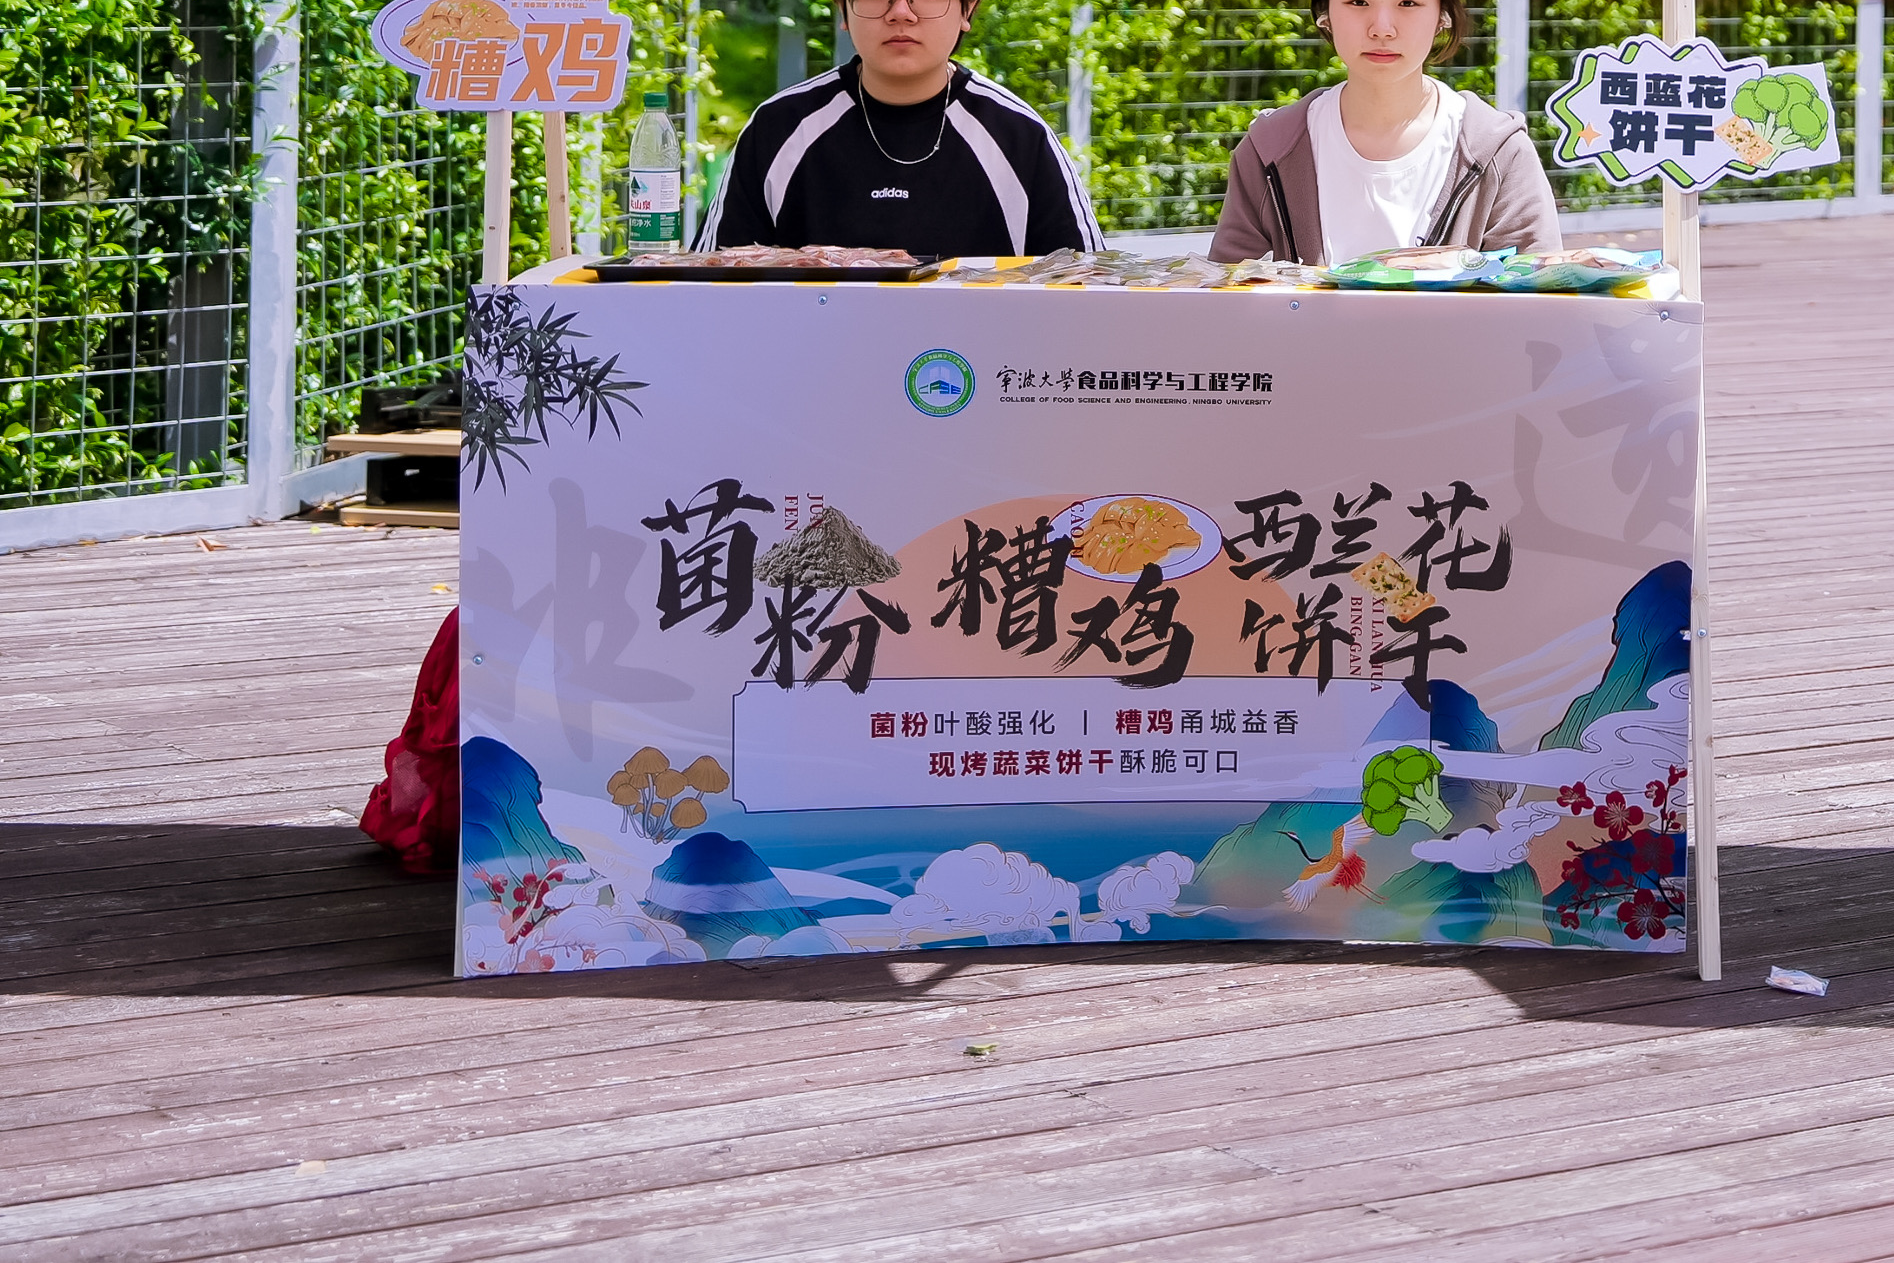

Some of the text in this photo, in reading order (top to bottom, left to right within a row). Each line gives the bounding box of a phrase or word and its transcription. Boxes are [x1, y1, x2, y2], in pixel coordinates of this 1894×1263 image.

[425, 18, 621, 102] 糟鸡
[1600, 71, 1727, 109] 西蓝花
[1609, 109, 1715, 156] 饼干
[871, 187, 909, 198] adidas
[1226, 398, 1273, 406] UNIVERSITY
[784, 495, 799, 532] FEN
[807, 493, 824, 529] JUN
[1070, 501, 1085, 539] CAO
[1222, 481, 1514, 592] 西兰花
[641, 478, 912, 695] 菌粉
[930, 515, 1195, 690] 糟鸡
[1372, 597, 1385, 614] XI
[1239, 582, 1468, 712] 饼干
[1349, 597, 1363, 676] BING GAN
[870, 708, 1300, 739] 菌粉叶酸强化 糟鸡甬城益香
[929, 748, 1240, 779] 现烤蔬菜饼干酥脆可口
